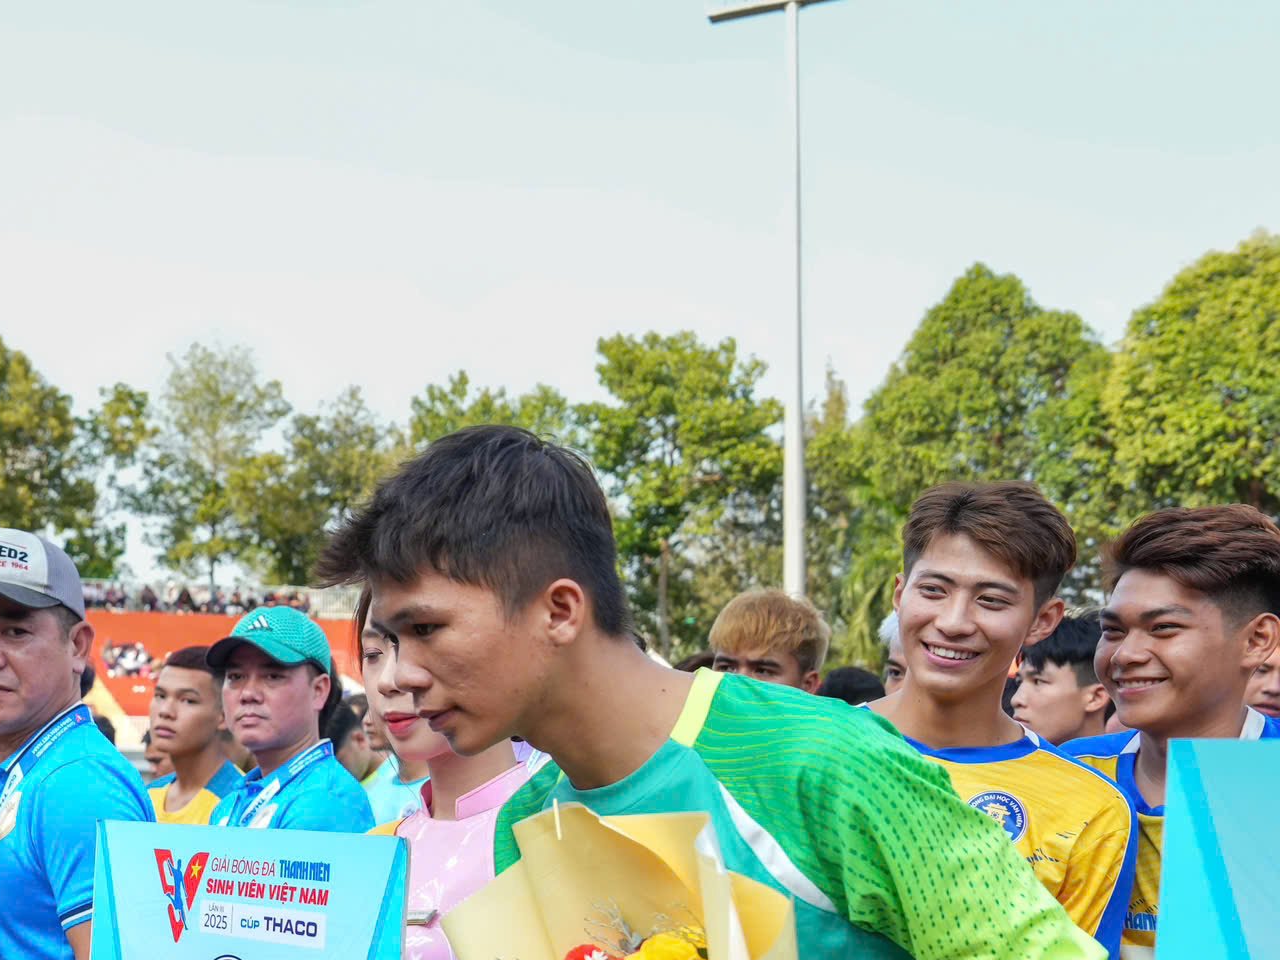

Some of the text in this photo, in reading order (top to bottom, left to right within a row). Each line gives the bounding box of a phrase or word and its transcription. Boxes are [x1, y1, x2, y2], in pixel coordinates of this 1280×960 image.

[11, 562, 30, 571] 1964
[211, 854, 230, 872] GIẢI
[231, 856, 259, 876] BÓNG
[261, 859, 275, 877] ĐÁ
[206, 878, 329, 906] SINH VIÊN VIỆT NAM
[204, 913, 228, 930] 2025
[240, 915, 318, 937] CÚP THACO
